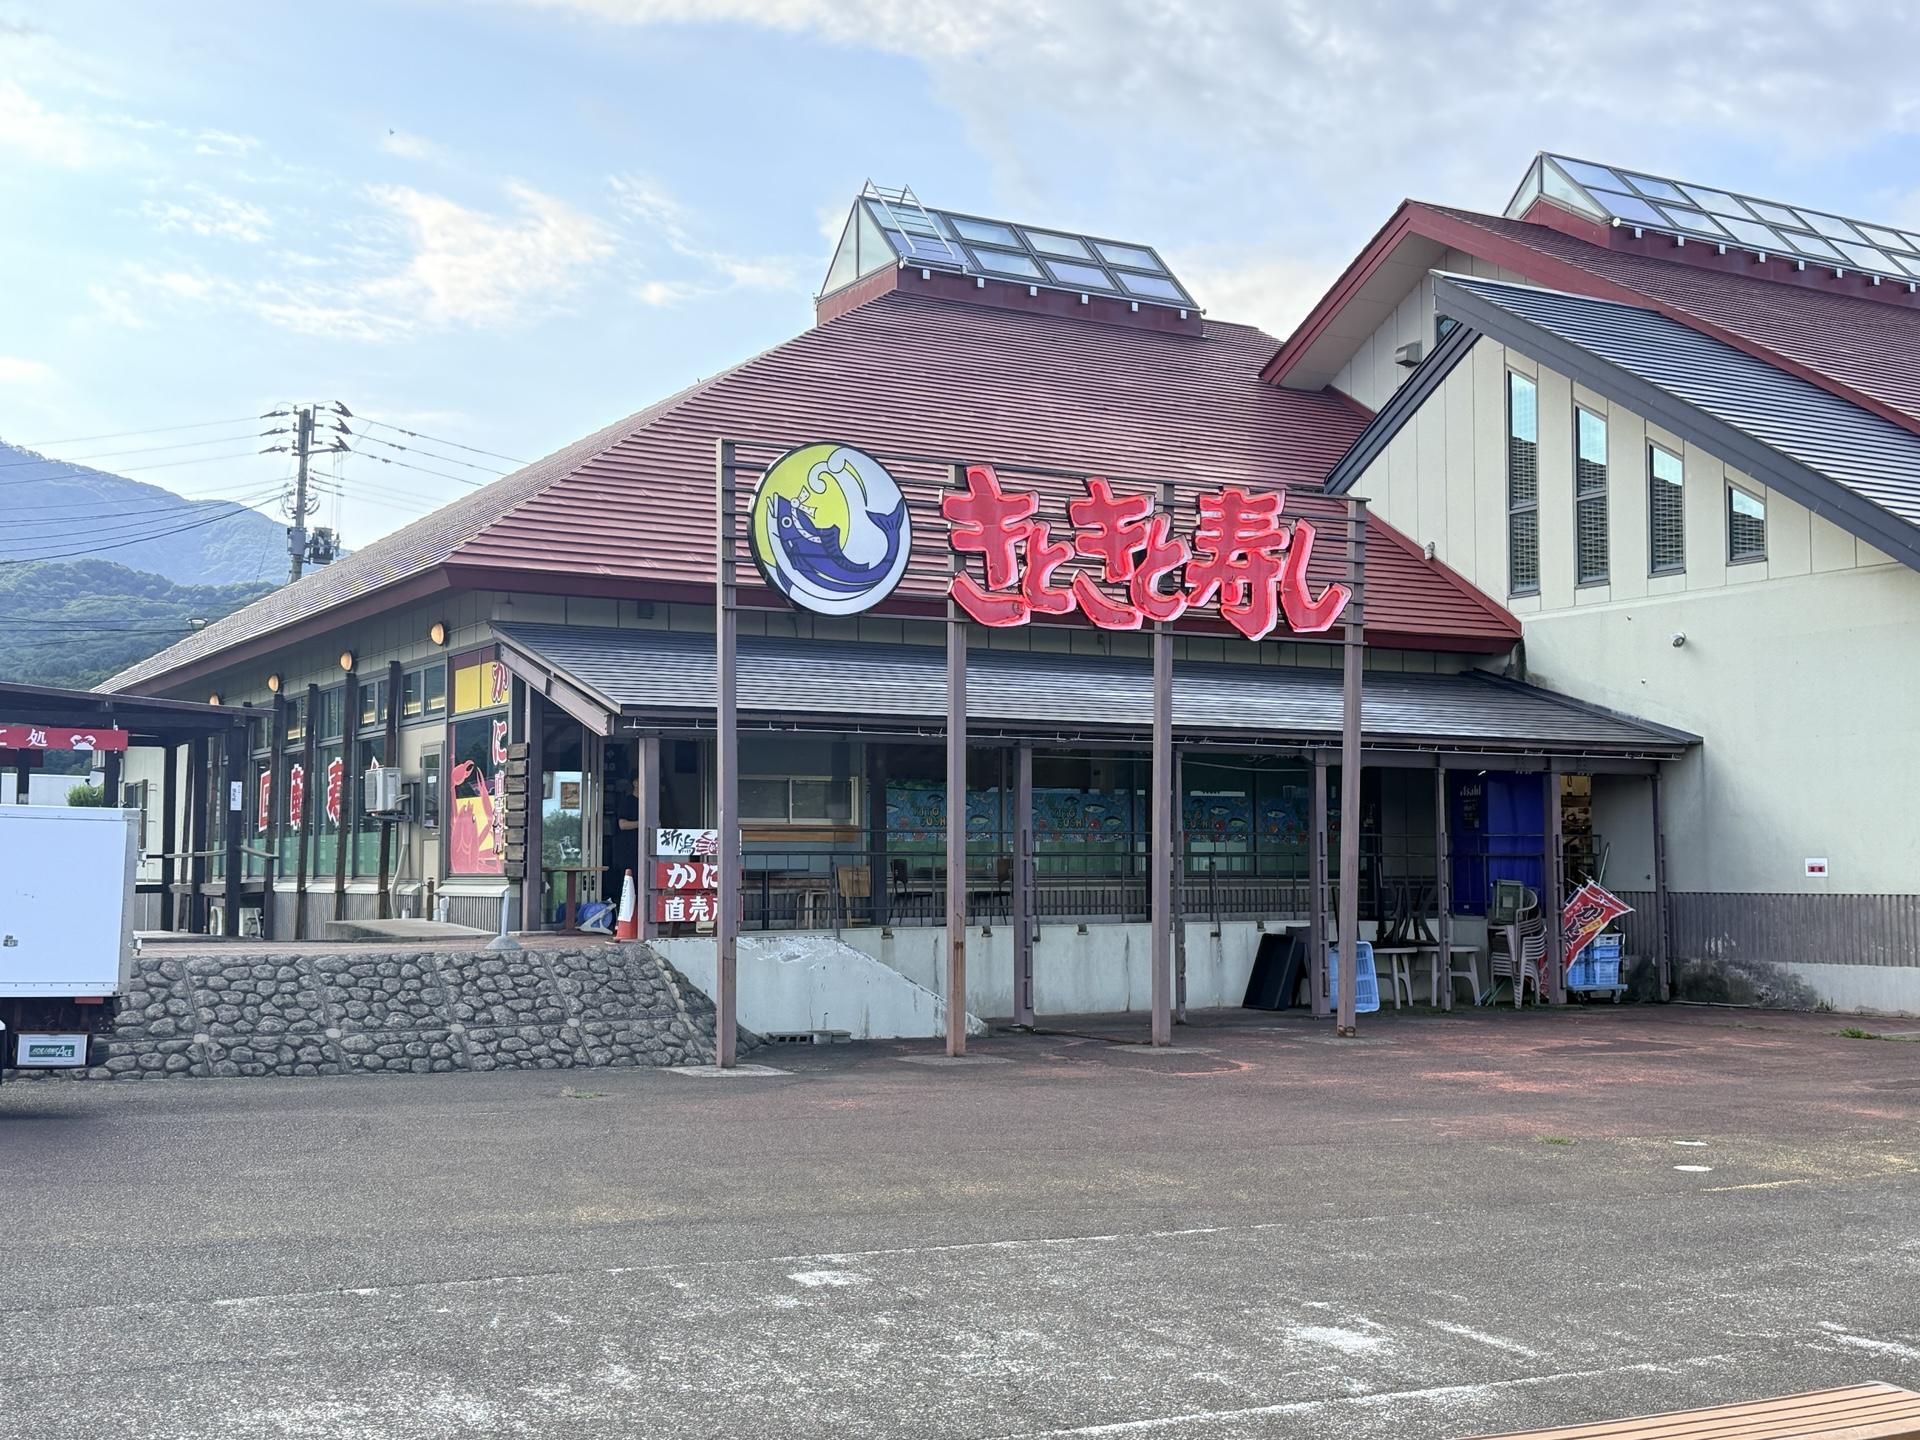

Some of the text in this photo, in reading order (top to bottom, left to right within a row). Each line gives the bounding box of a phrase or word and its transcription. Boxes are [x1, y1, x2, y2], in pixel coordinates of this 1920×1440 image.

[940, 464, 1352, 641] きときと寿し
[660, 829, 696, 856] 新潟
[665, 896, 718, 921] 直売
